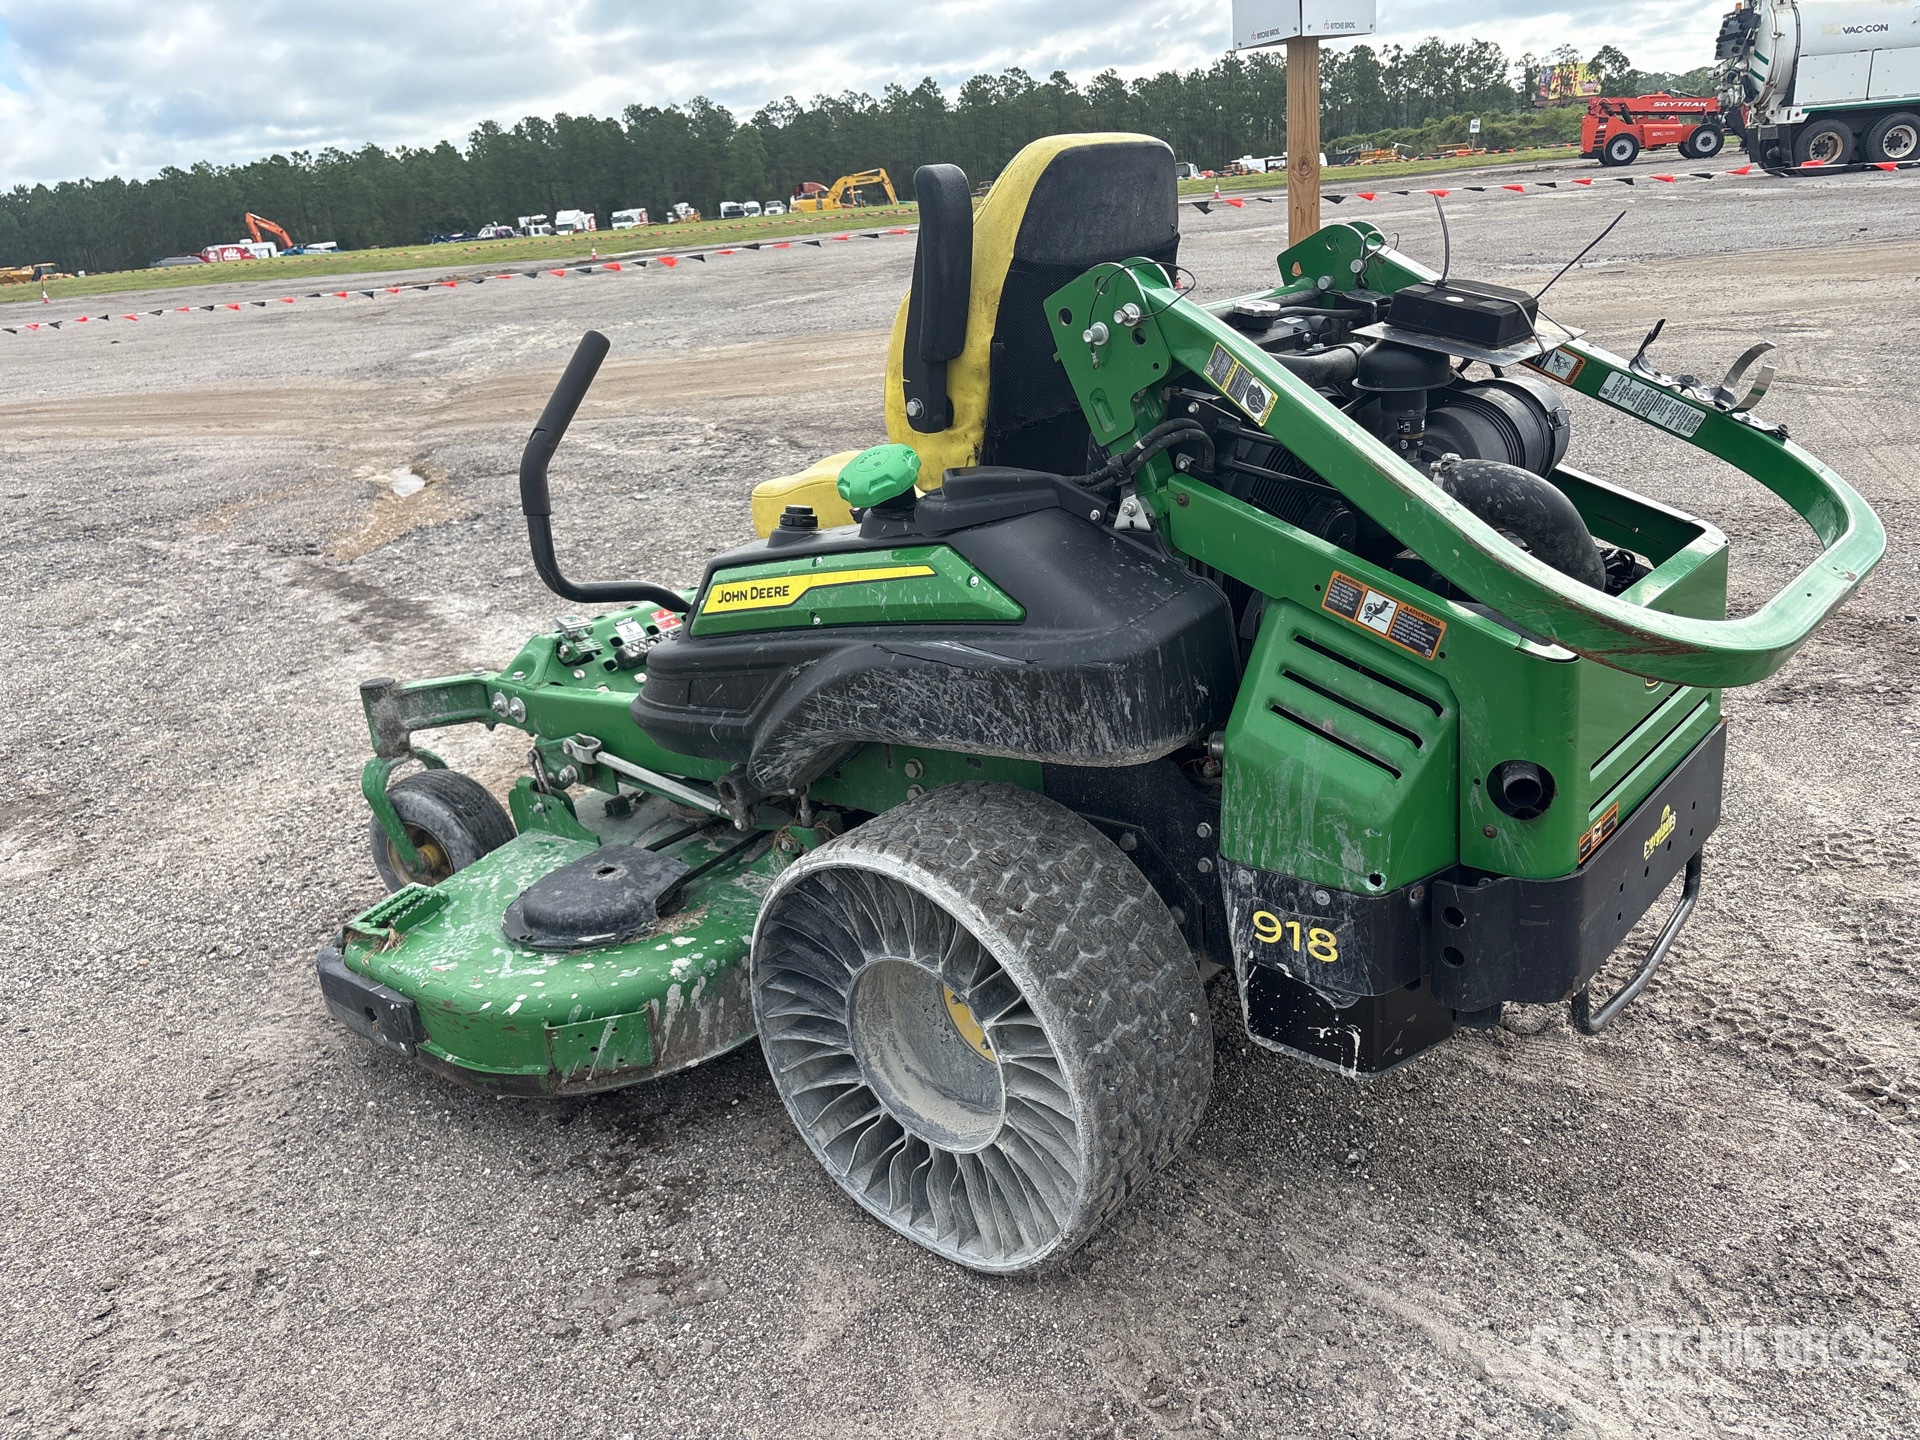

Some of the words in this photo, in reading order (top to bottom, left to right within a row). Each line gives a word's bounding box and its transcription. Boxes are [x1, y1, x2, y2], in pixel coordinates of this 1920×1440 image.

[1257, 30, 1270, 39] RITCHIE
[718, 589, 748, 604] JOHN
[750, 585, 790, 600] DEERE
[1408, 607, 1441, 626] ADVERTENCIA
[1252, 910, 1339, 963] 918
